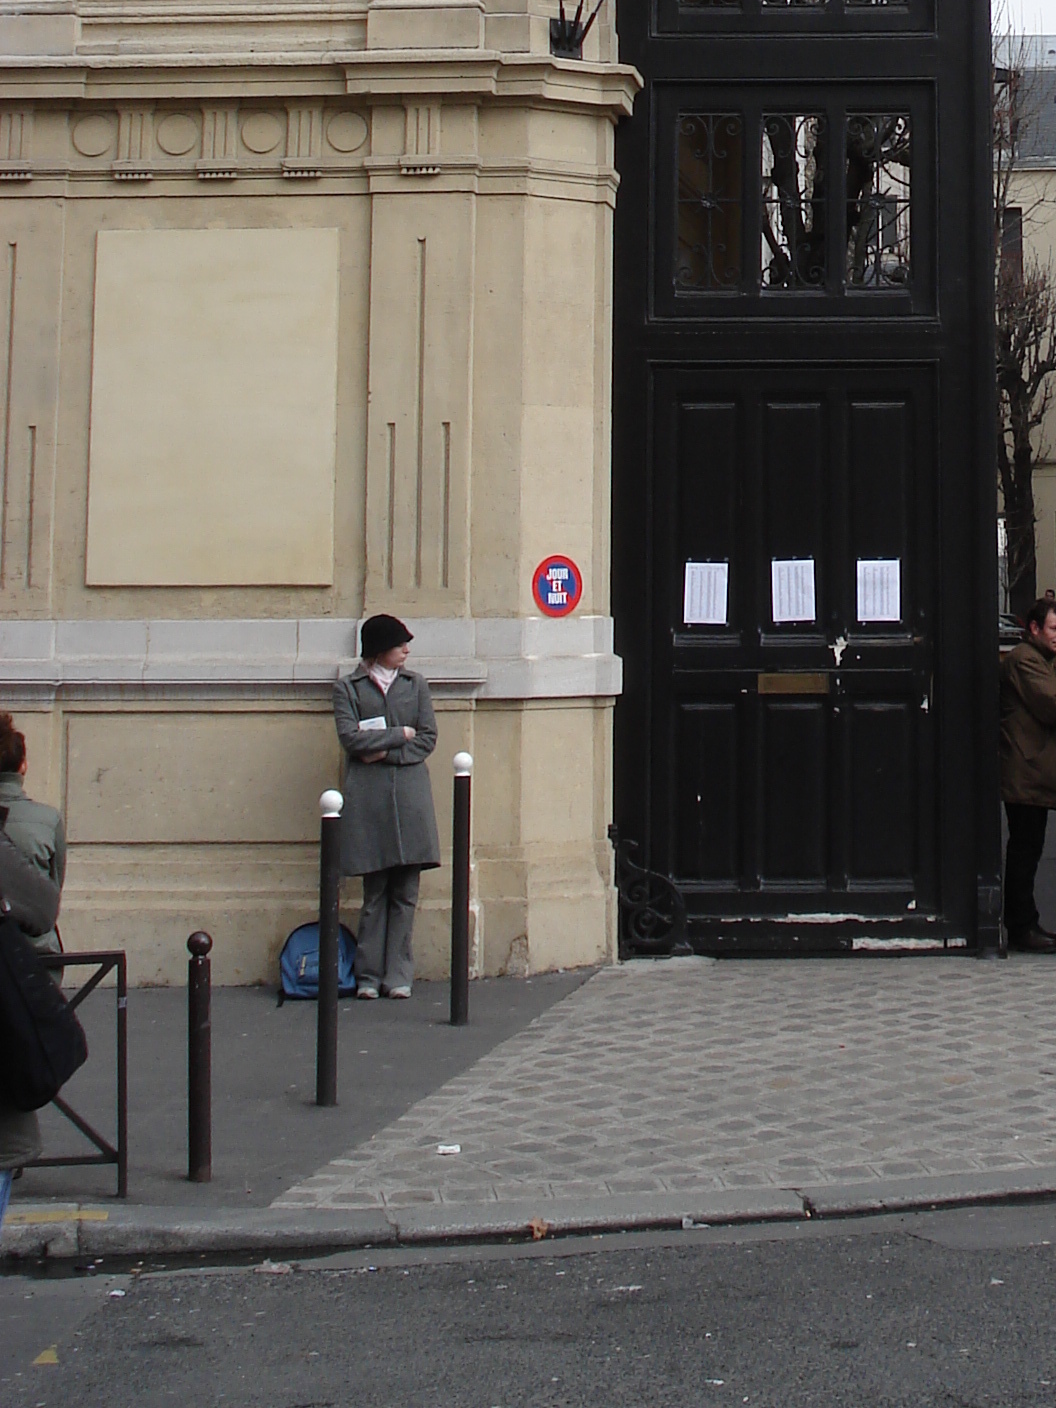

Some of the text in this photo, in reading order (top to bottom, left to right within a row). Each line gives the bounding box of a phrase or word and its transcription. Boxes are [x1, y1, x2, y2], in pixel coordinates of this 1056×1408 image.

[546, 568, 569, 580] JOUR
[552, 580, 562, 592] ET
[547, 592, 568, 604] NUIT
